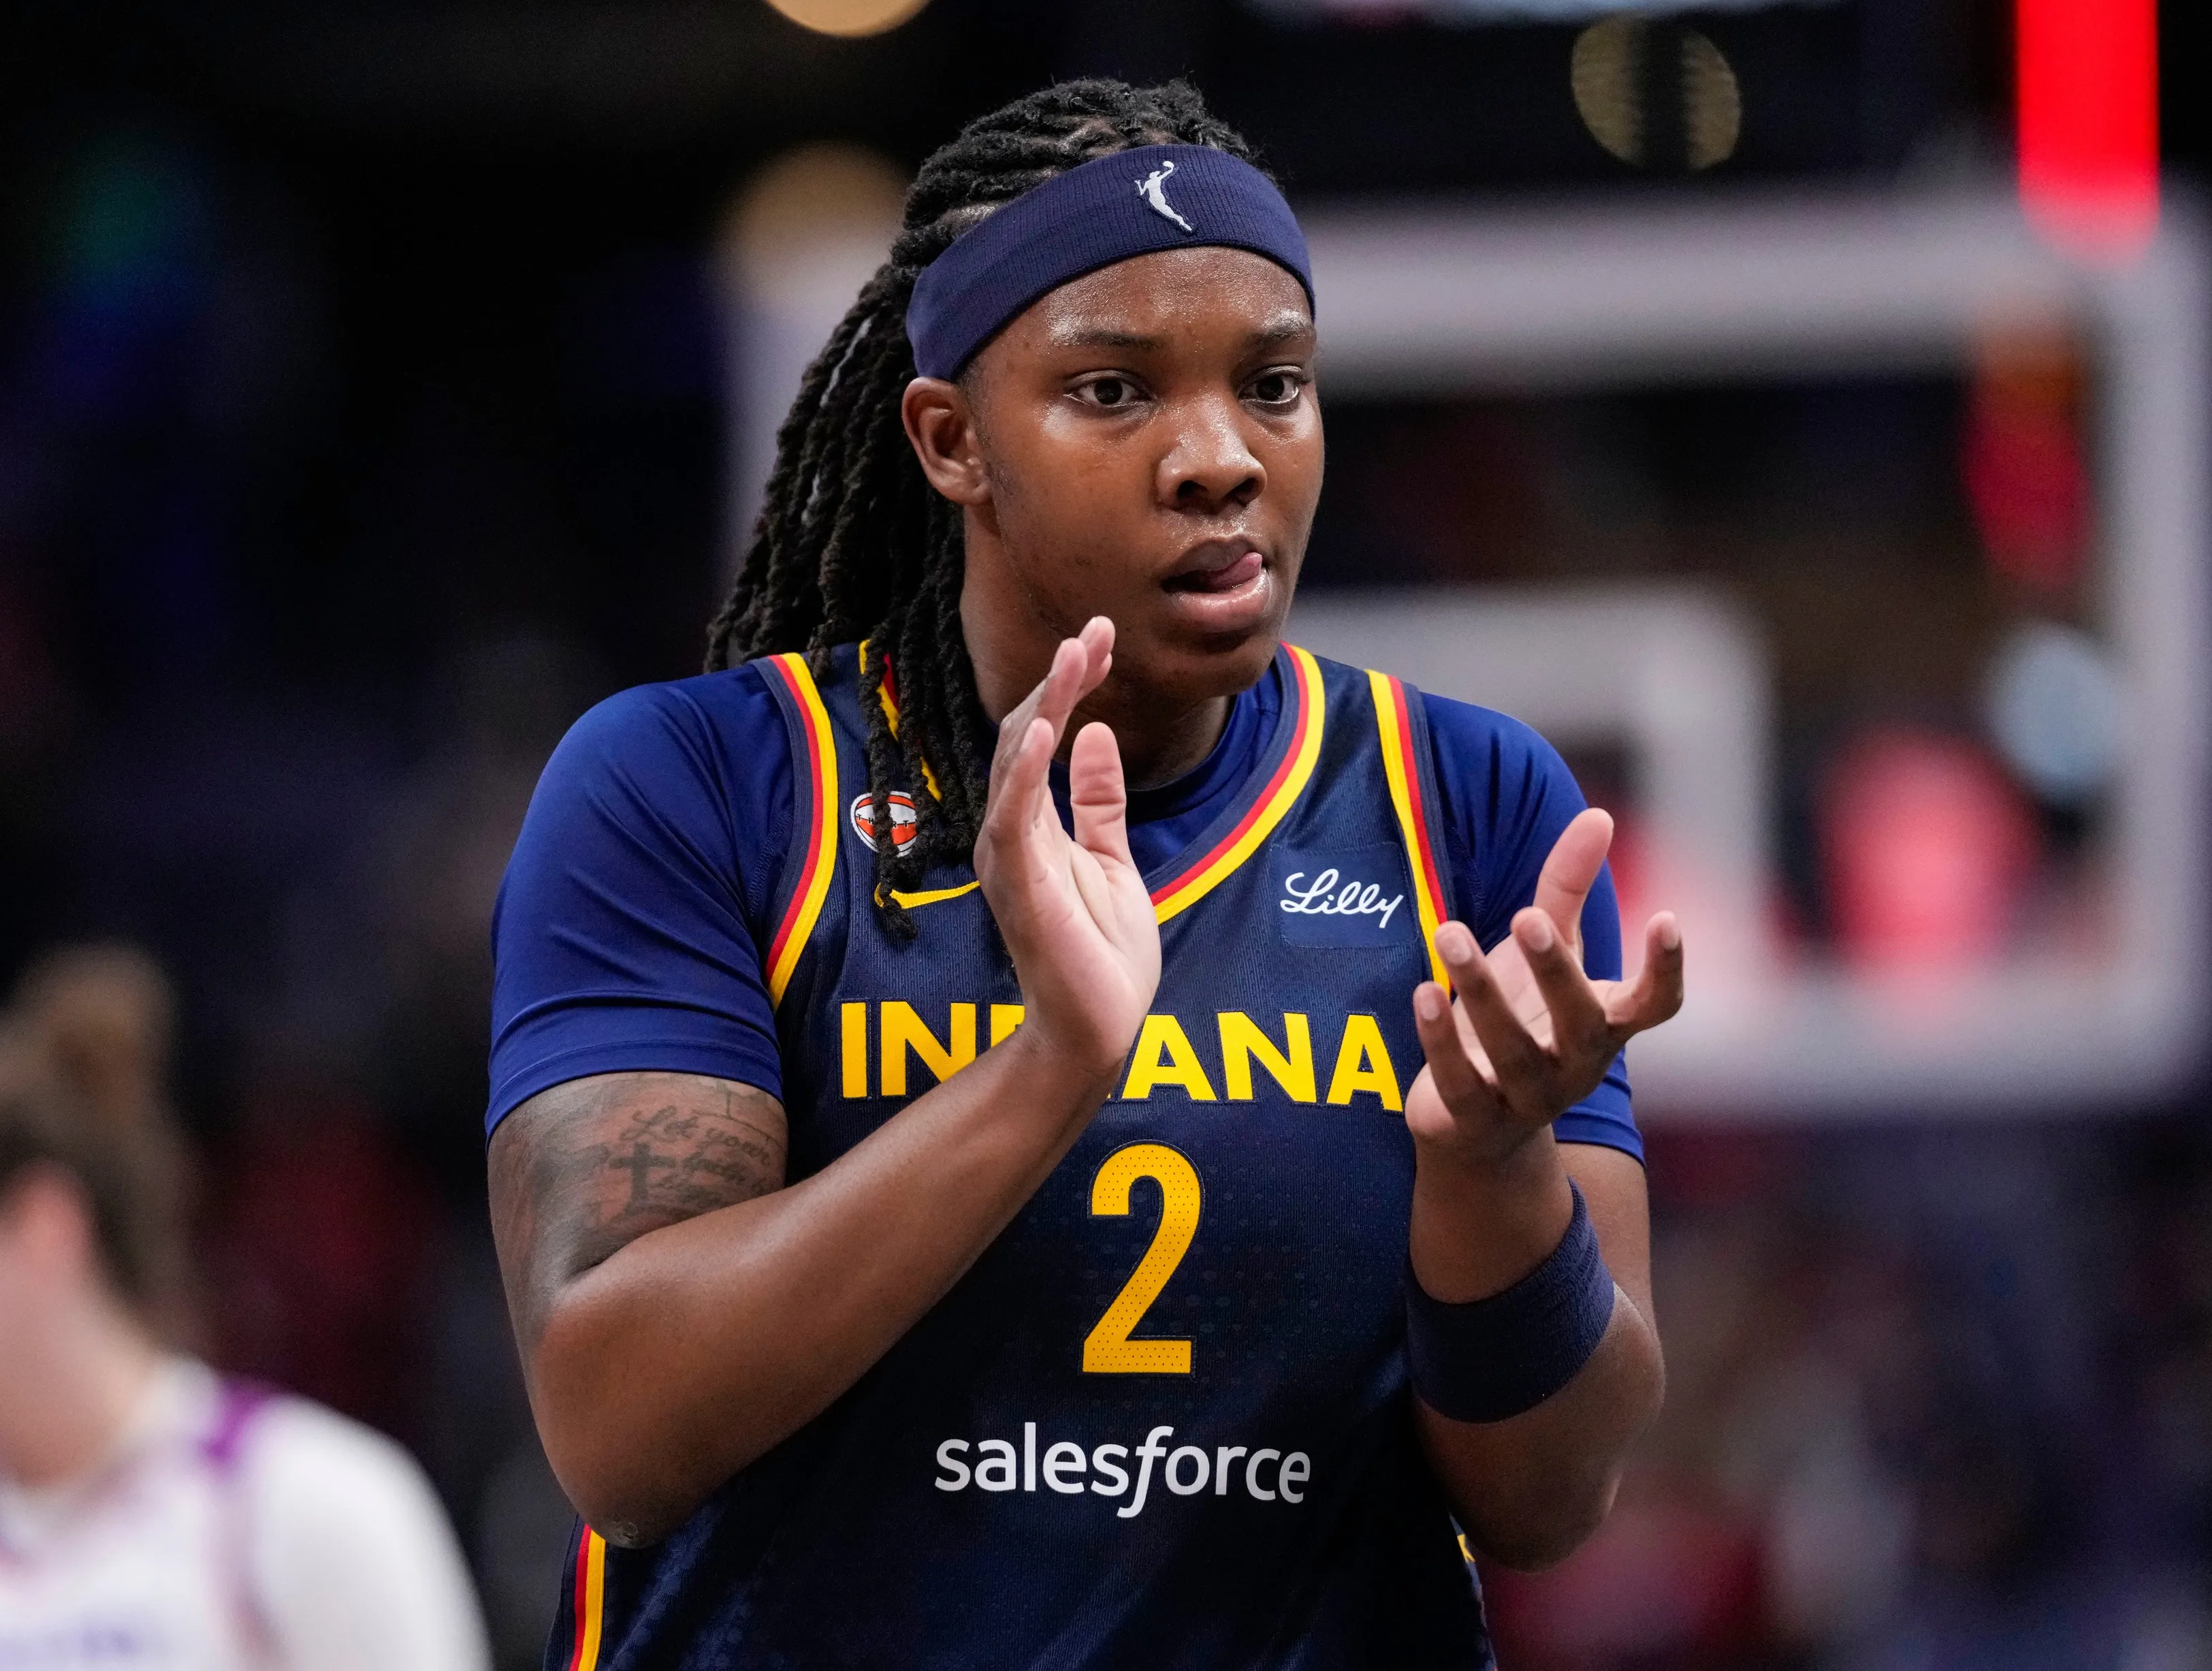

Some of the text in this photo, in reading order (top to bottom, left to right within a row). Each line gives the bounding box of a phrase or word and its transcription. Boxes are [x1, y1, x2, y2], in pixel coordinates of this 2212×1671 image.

[856, 814, 917, 829] THRT
[1280, 868, 1404, 929] Lilly
[841, 1001, 1404, 1113] INANA
[1083, 1144, 1201, 1373] 2
[935, 1422, 1311, 1518] salesforce
